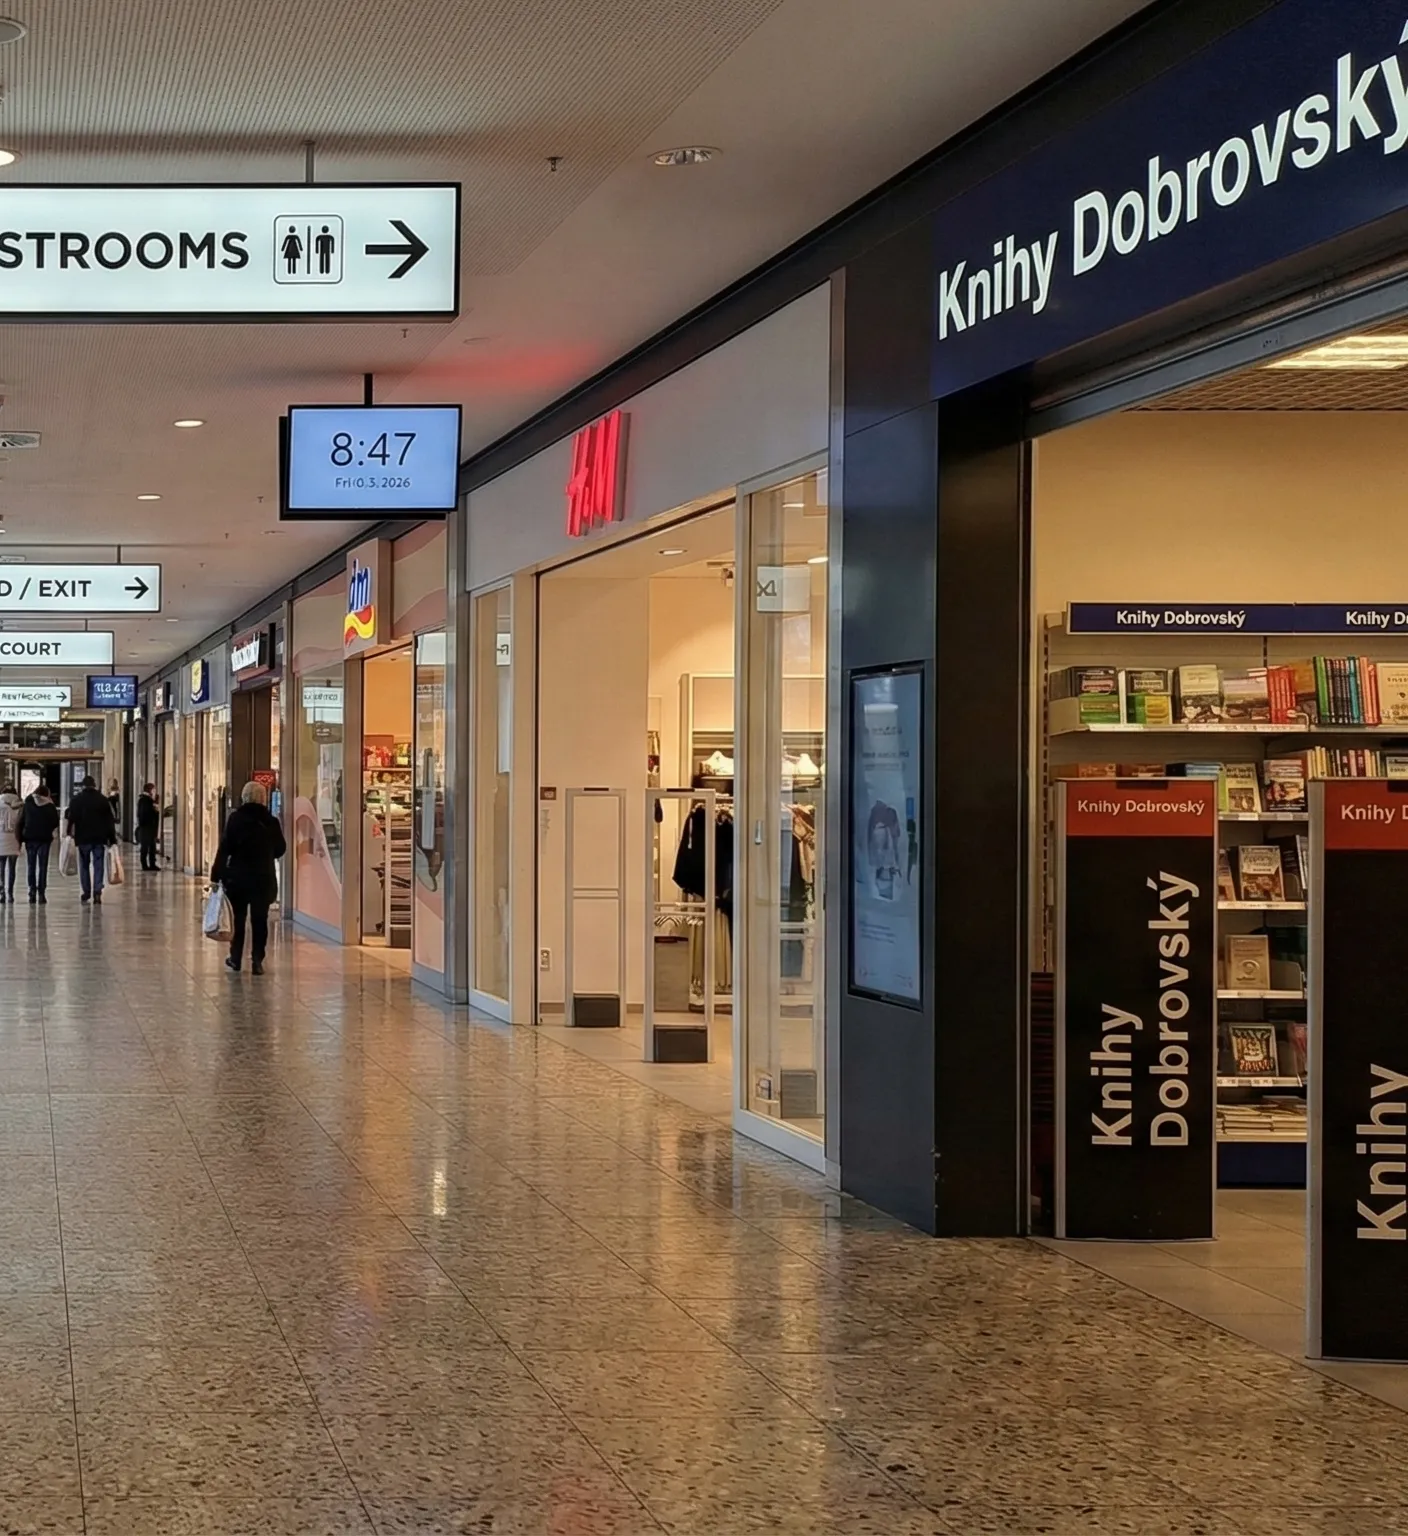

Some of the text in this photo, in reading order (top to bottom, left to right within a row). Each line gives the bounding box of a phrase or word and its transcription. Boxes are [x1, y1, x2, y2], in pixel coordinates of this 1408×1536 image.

[938, 230, 1060, 341] Knihy
[330, 432, 417, 467] 8:47
[335, 477, 352, 489] Fri
[381, 477, 411, 489] 2026
[18, 577, 32, 601] /
[38, 579, 92, 598] EXIT
[349, 557, 371, 614] dm
[1116, 610, 1246, 629] Knihy Dobrovský
[1345, 610, 1390, 629] Knihy
[0, 641, 62, 656] COURT
[1077, 799, 1205, 816] Knihy Dobrovský
[1341, 804, 1396, 824] Knihy
[1146, 870, 1200, 1147] Dobrovský
[1089, 1002, 1144, 1147] Knihy
[1356, 1062, 1408, 1241] Knihy
